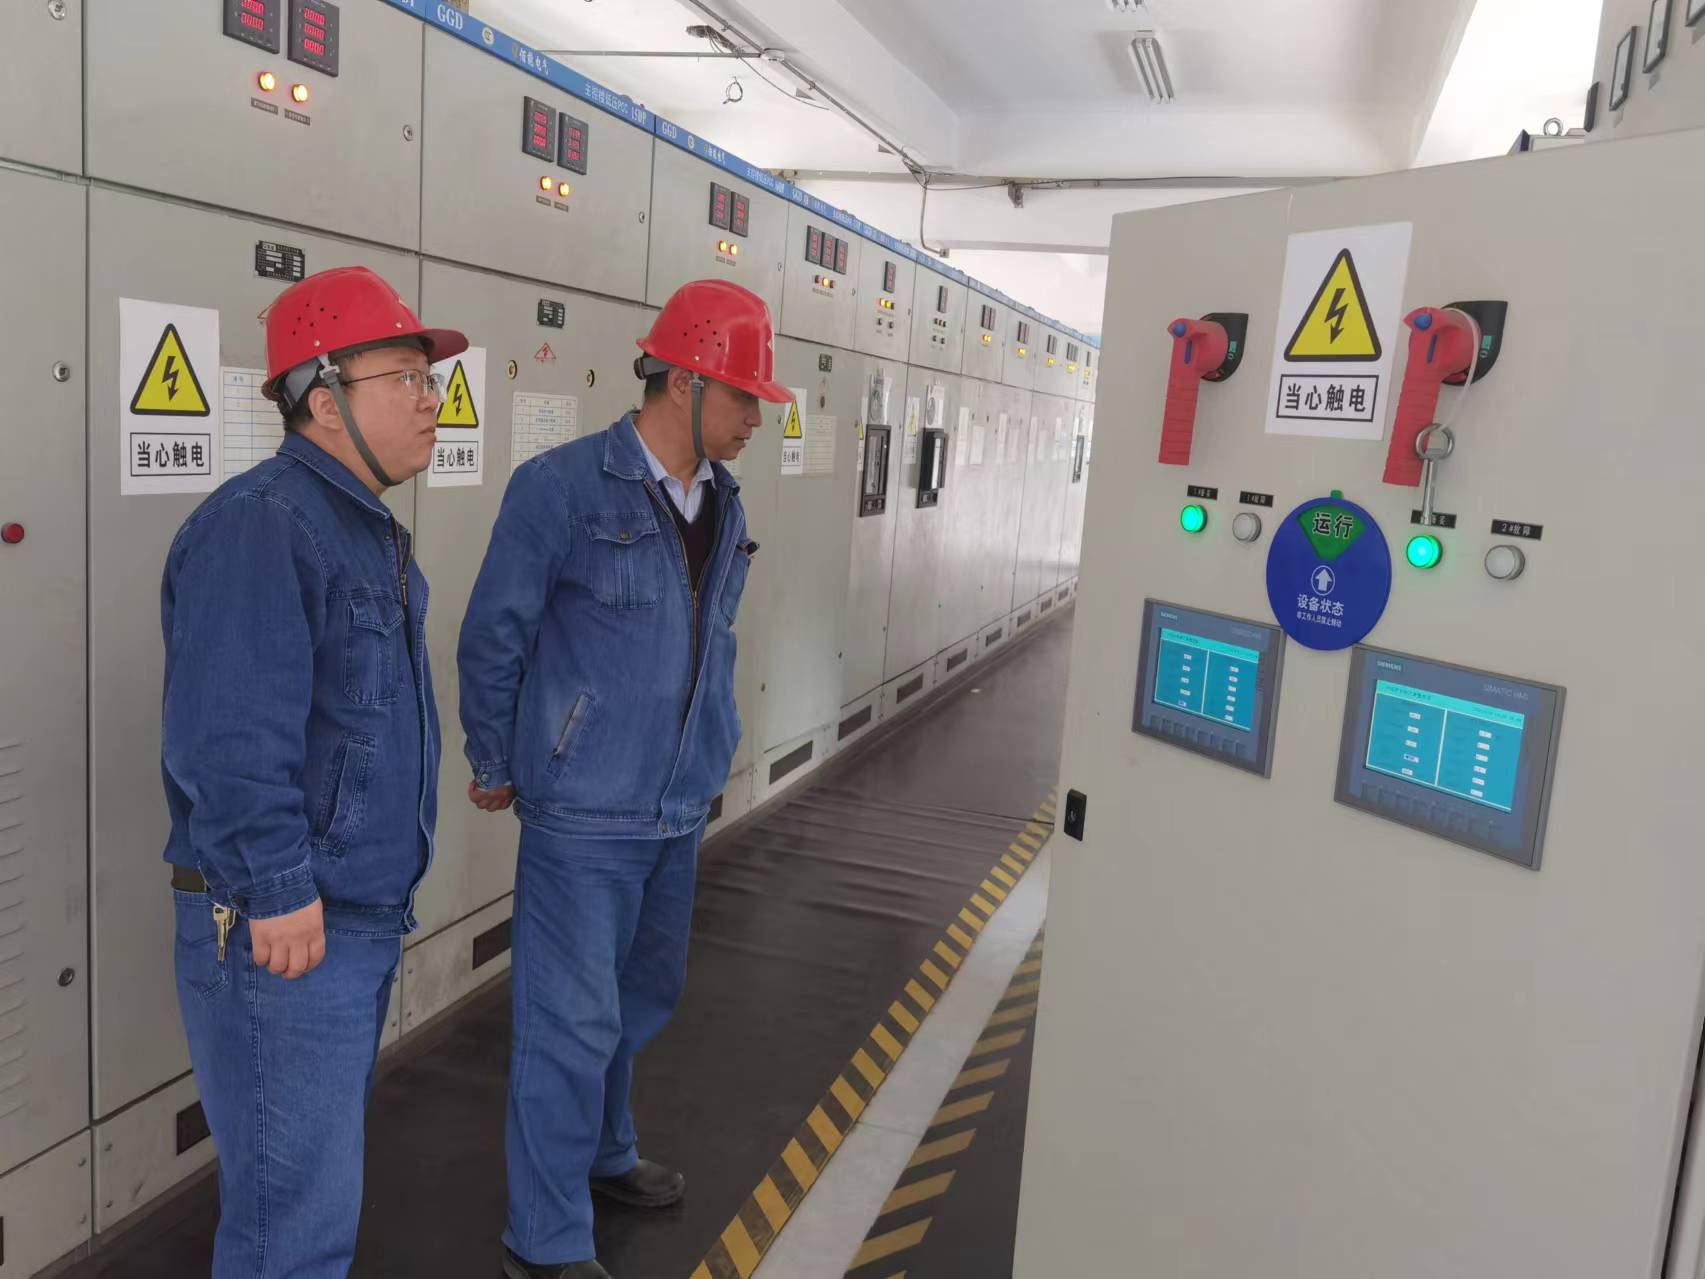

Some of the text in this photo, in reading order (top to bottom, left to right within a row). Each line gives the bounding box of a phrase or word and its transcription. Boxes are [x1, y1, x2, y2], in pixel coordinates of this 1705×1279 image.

[437, 4, 464, 30] GGD
[662, 121, 677, 139] GGD
[1285, 383, 1366, 412] 当心触电
[137, 440, 205, 468] 当心触电
[436, 447, 474, 467] 当心触电
[1312, 511, 1353, 539] 运行
[1297, 593, 1344, 616] 设备状态
[1376, 660, 1402, 672] SIEMENS
